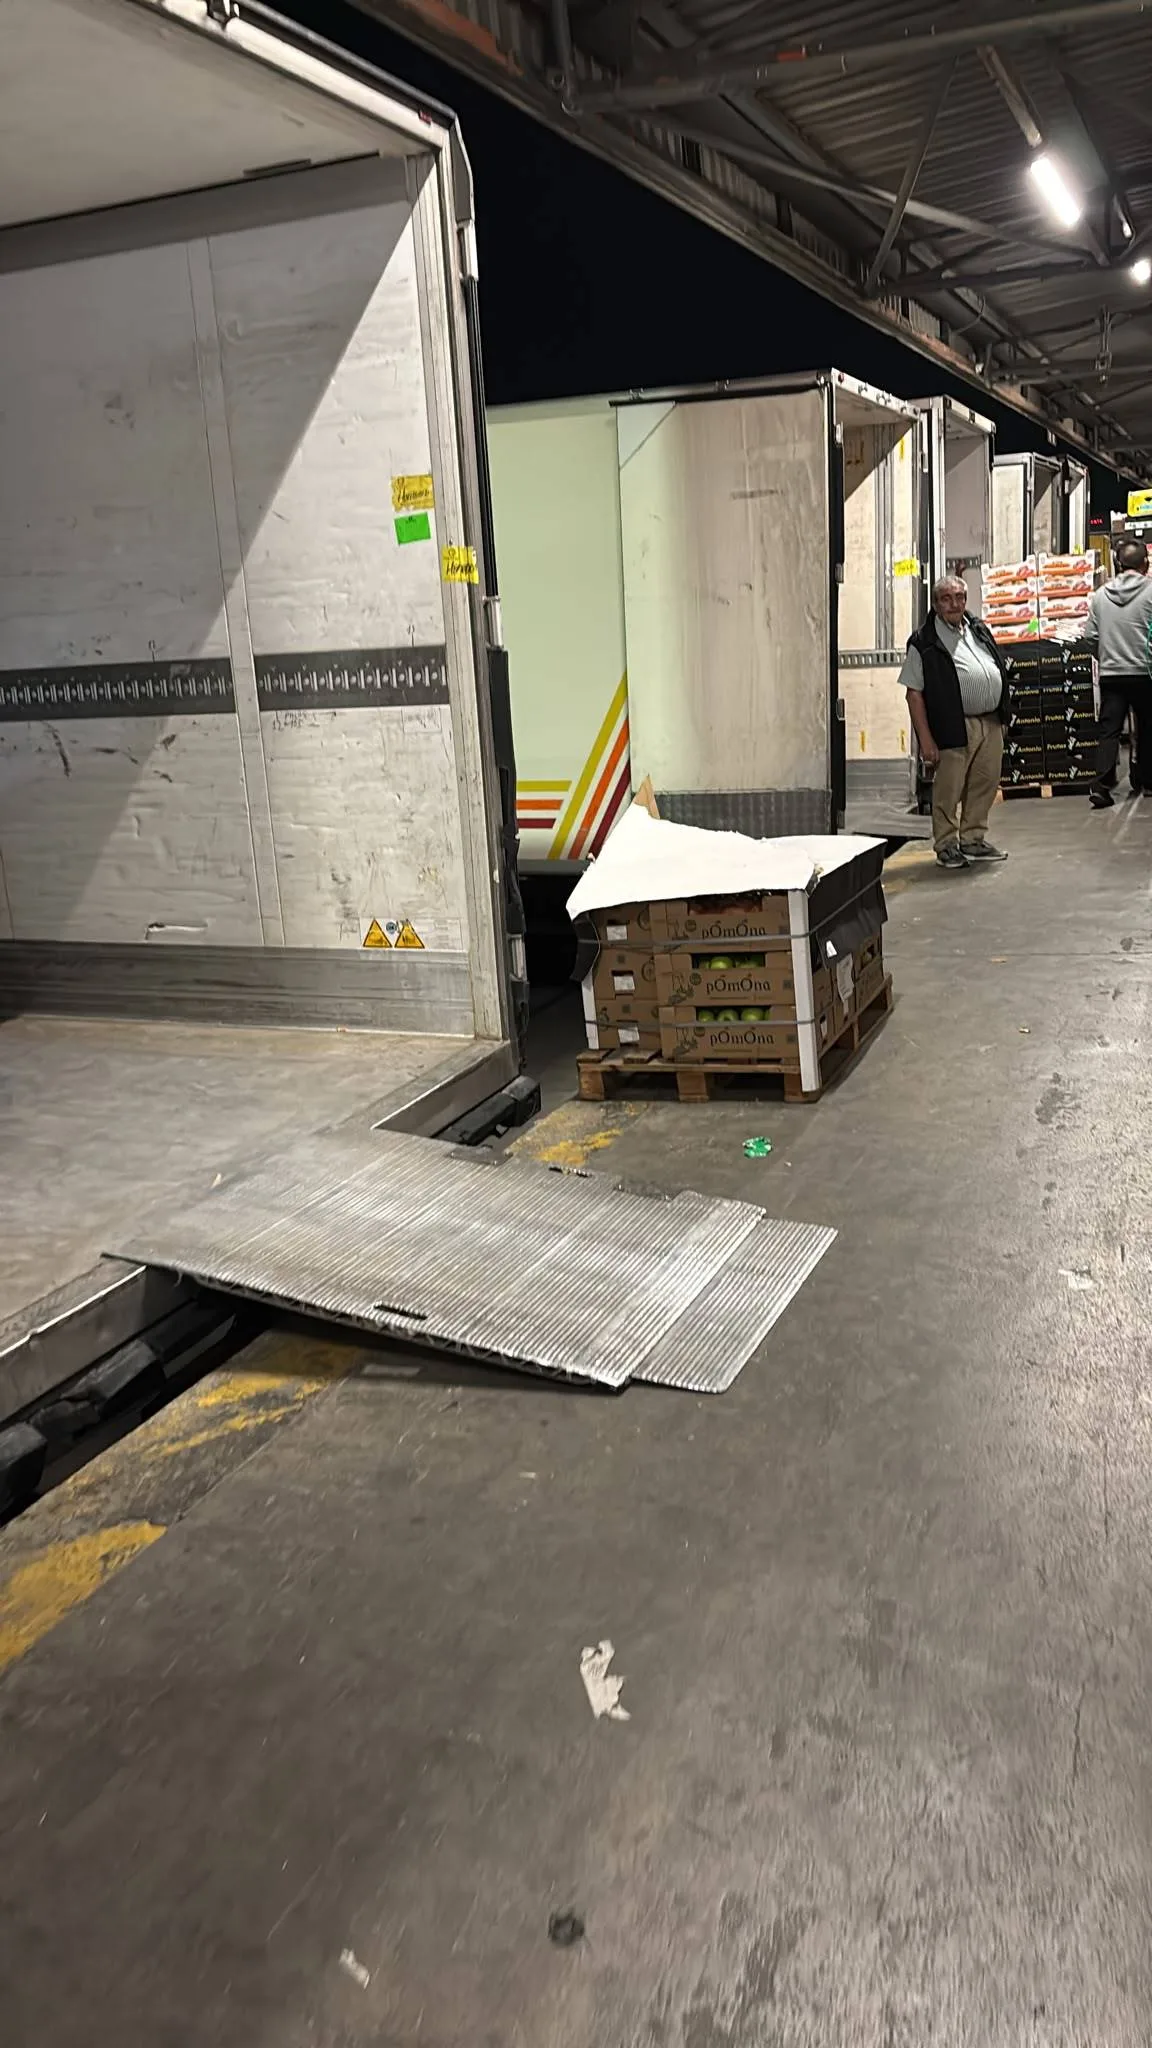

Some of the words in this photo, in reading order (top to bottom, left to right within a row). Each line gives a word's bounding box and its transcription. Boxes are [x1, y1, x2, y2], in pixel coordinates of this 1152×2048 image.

[1041, 656, 1061, 664] Frutas
[1016, 715, 1041, 725] Antonio
[1045, 713, 1065, 721] Frutas
[1017, 745, 1042, 754] Antonio
[1047, 743, 1066, 751] Frutas
[1048, 771, 1068, 779] Frutas
